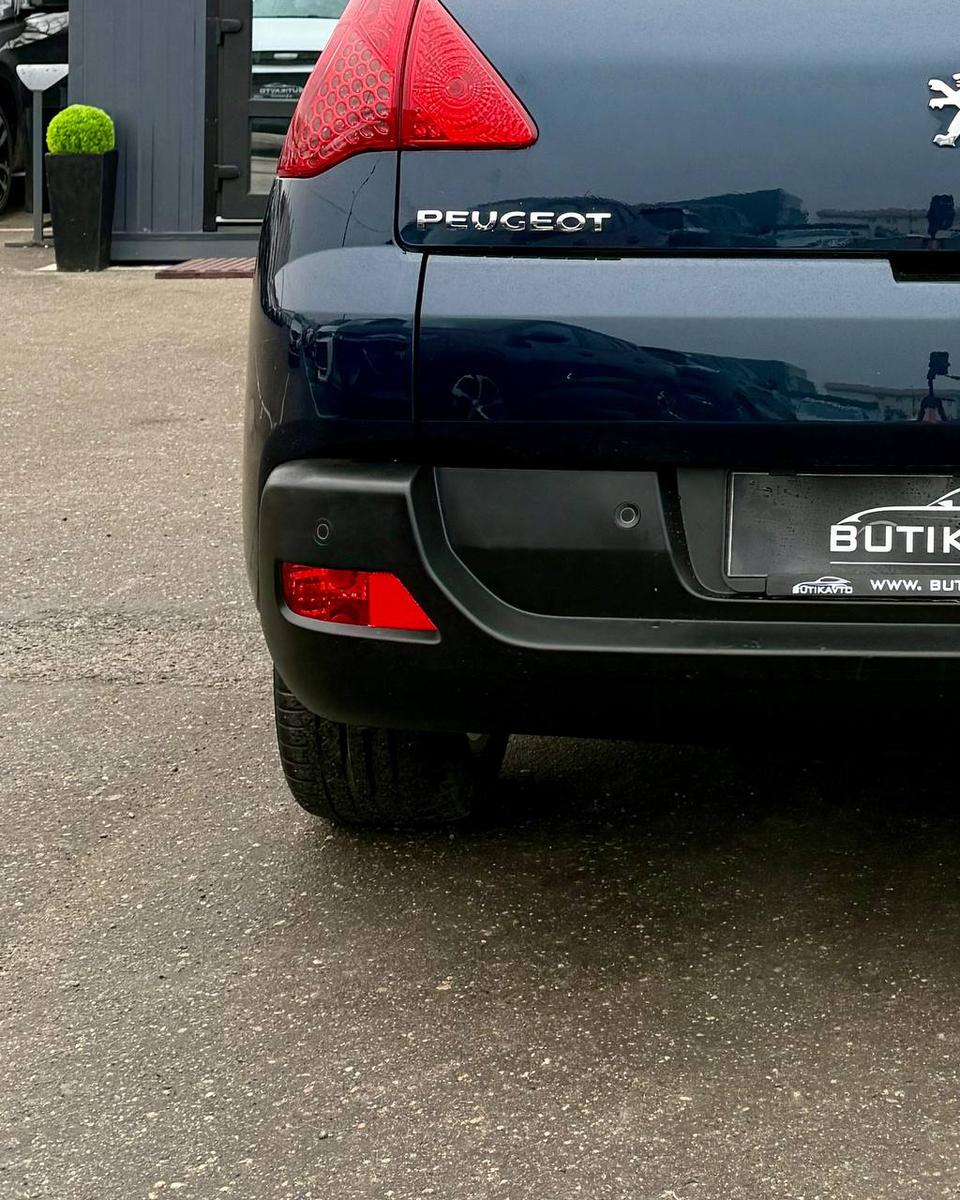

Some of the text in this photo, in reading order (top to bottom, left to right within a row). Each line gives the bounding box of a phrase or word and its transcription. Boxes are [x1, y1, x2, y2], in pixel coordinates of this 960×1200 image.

[416, 209, 612, 232] PEUGEOT
[792, 585, 853, 594] BUTIKAVTO
[870, 579, 922, 592] WWW.
